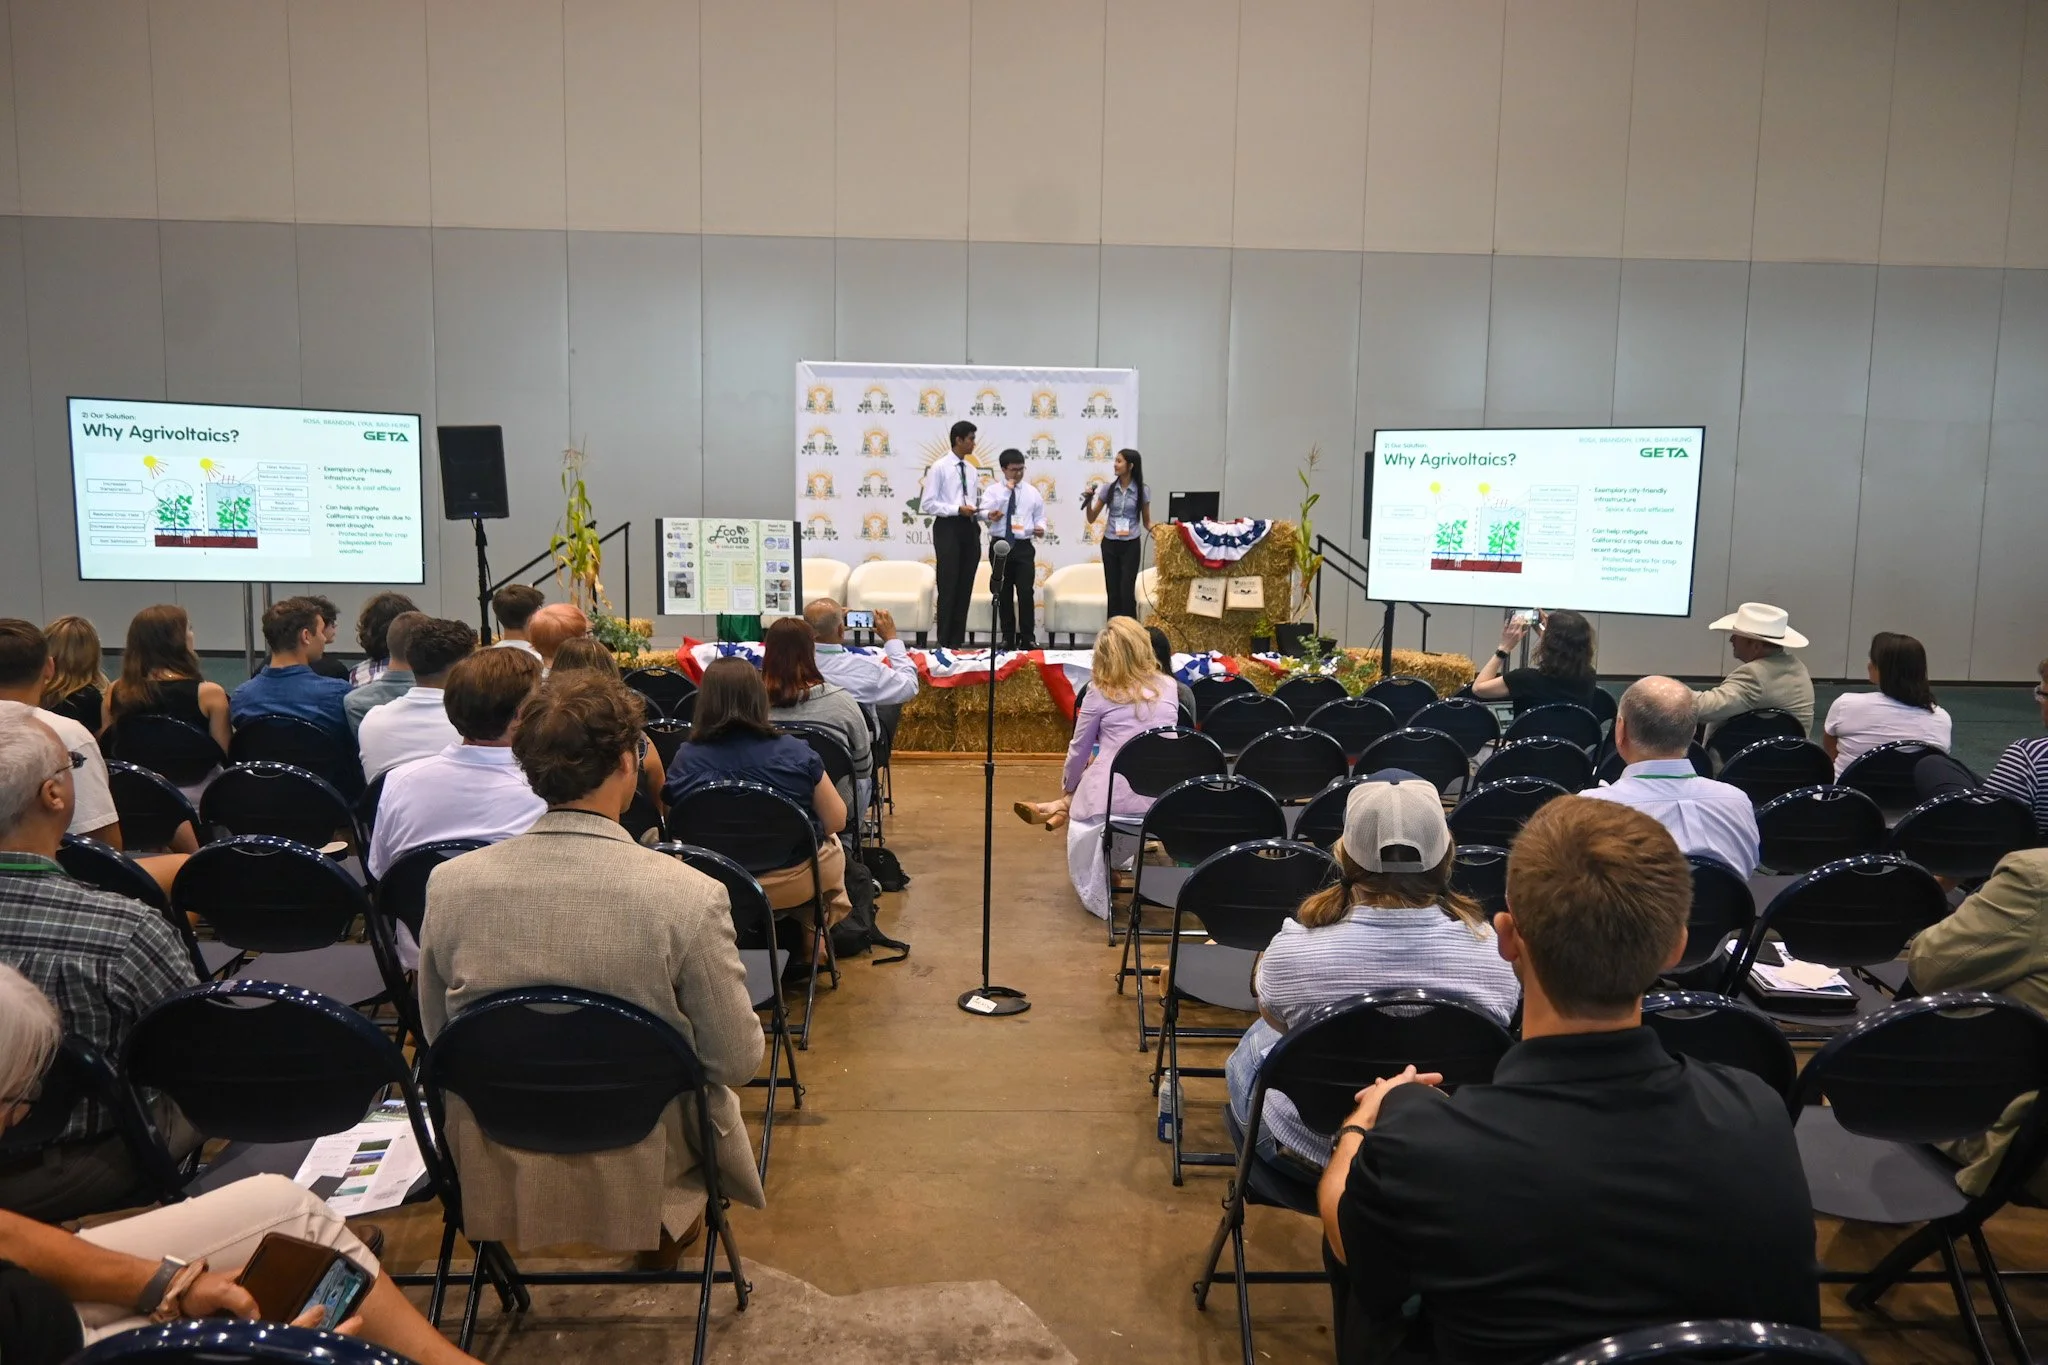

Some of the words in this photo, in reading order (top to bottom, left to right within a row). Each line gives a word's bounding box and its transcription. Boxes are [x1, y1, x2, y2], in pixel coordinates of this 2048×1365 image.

[83, 423, 123, 441] Why
[129, 425, 239, 442] Agrivoltaics?
[364, 431, 408, 441] GETA
[1640, 448, 1689, 457] GETA
[1384, 453, 1415, 468] Why
[1420, 452, 1517, 469] Agrivoltaics?
[906, 531, 932, 544] SOLA
